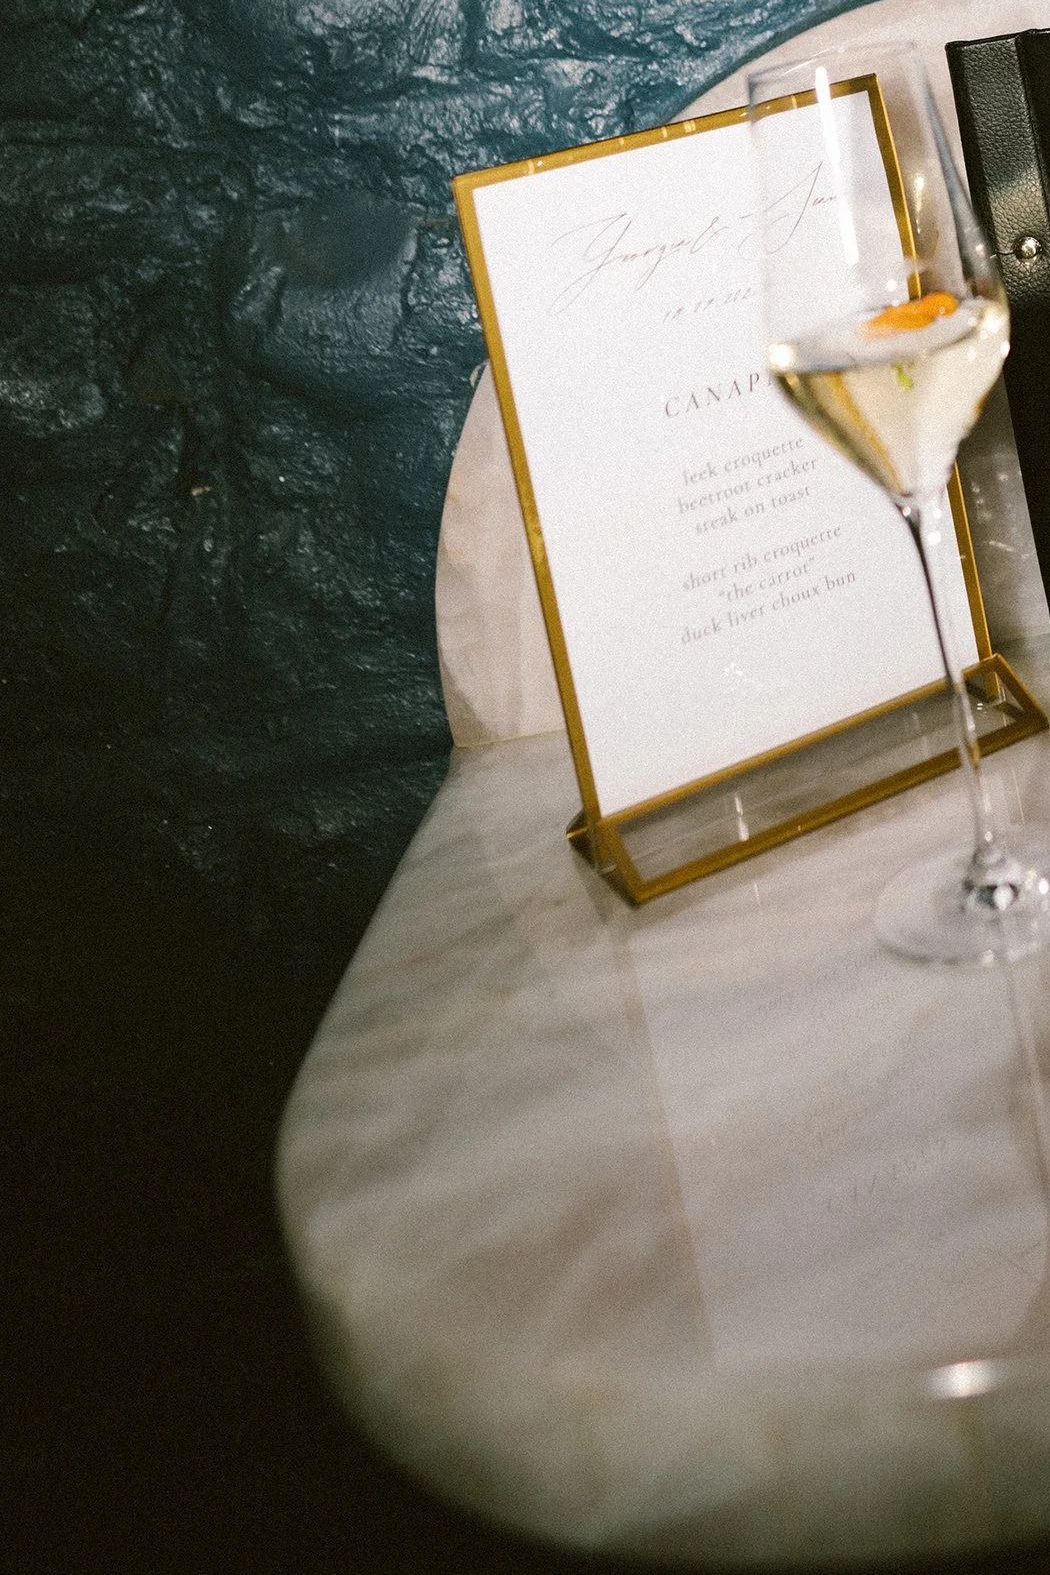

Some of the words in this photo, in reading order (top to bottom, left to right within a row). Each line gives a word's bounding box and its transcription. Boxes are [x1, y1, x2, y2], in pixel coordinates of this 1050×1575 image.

[690, 216, 729, 255] &
[678, 481, 752, 514] beetroot
[757, 458, 817, 487] cracker
[683, 462, 718, 486] leek
[724, 437, 803, 473] croquette
[697, 508, 738, 534] steak
[744, 502, 764, 517] on
[771, 485, 810, 508] toast
[682, 565, 726, 591] short
[733, 553, 757, 574] rib
[763, 525, 841, 563] croquette
[681, 617, 722, 645] duck
[728, 604, 765, 627] liver
[772, 585, 820, 611] choux
[826, 571, 856, 592] bun
